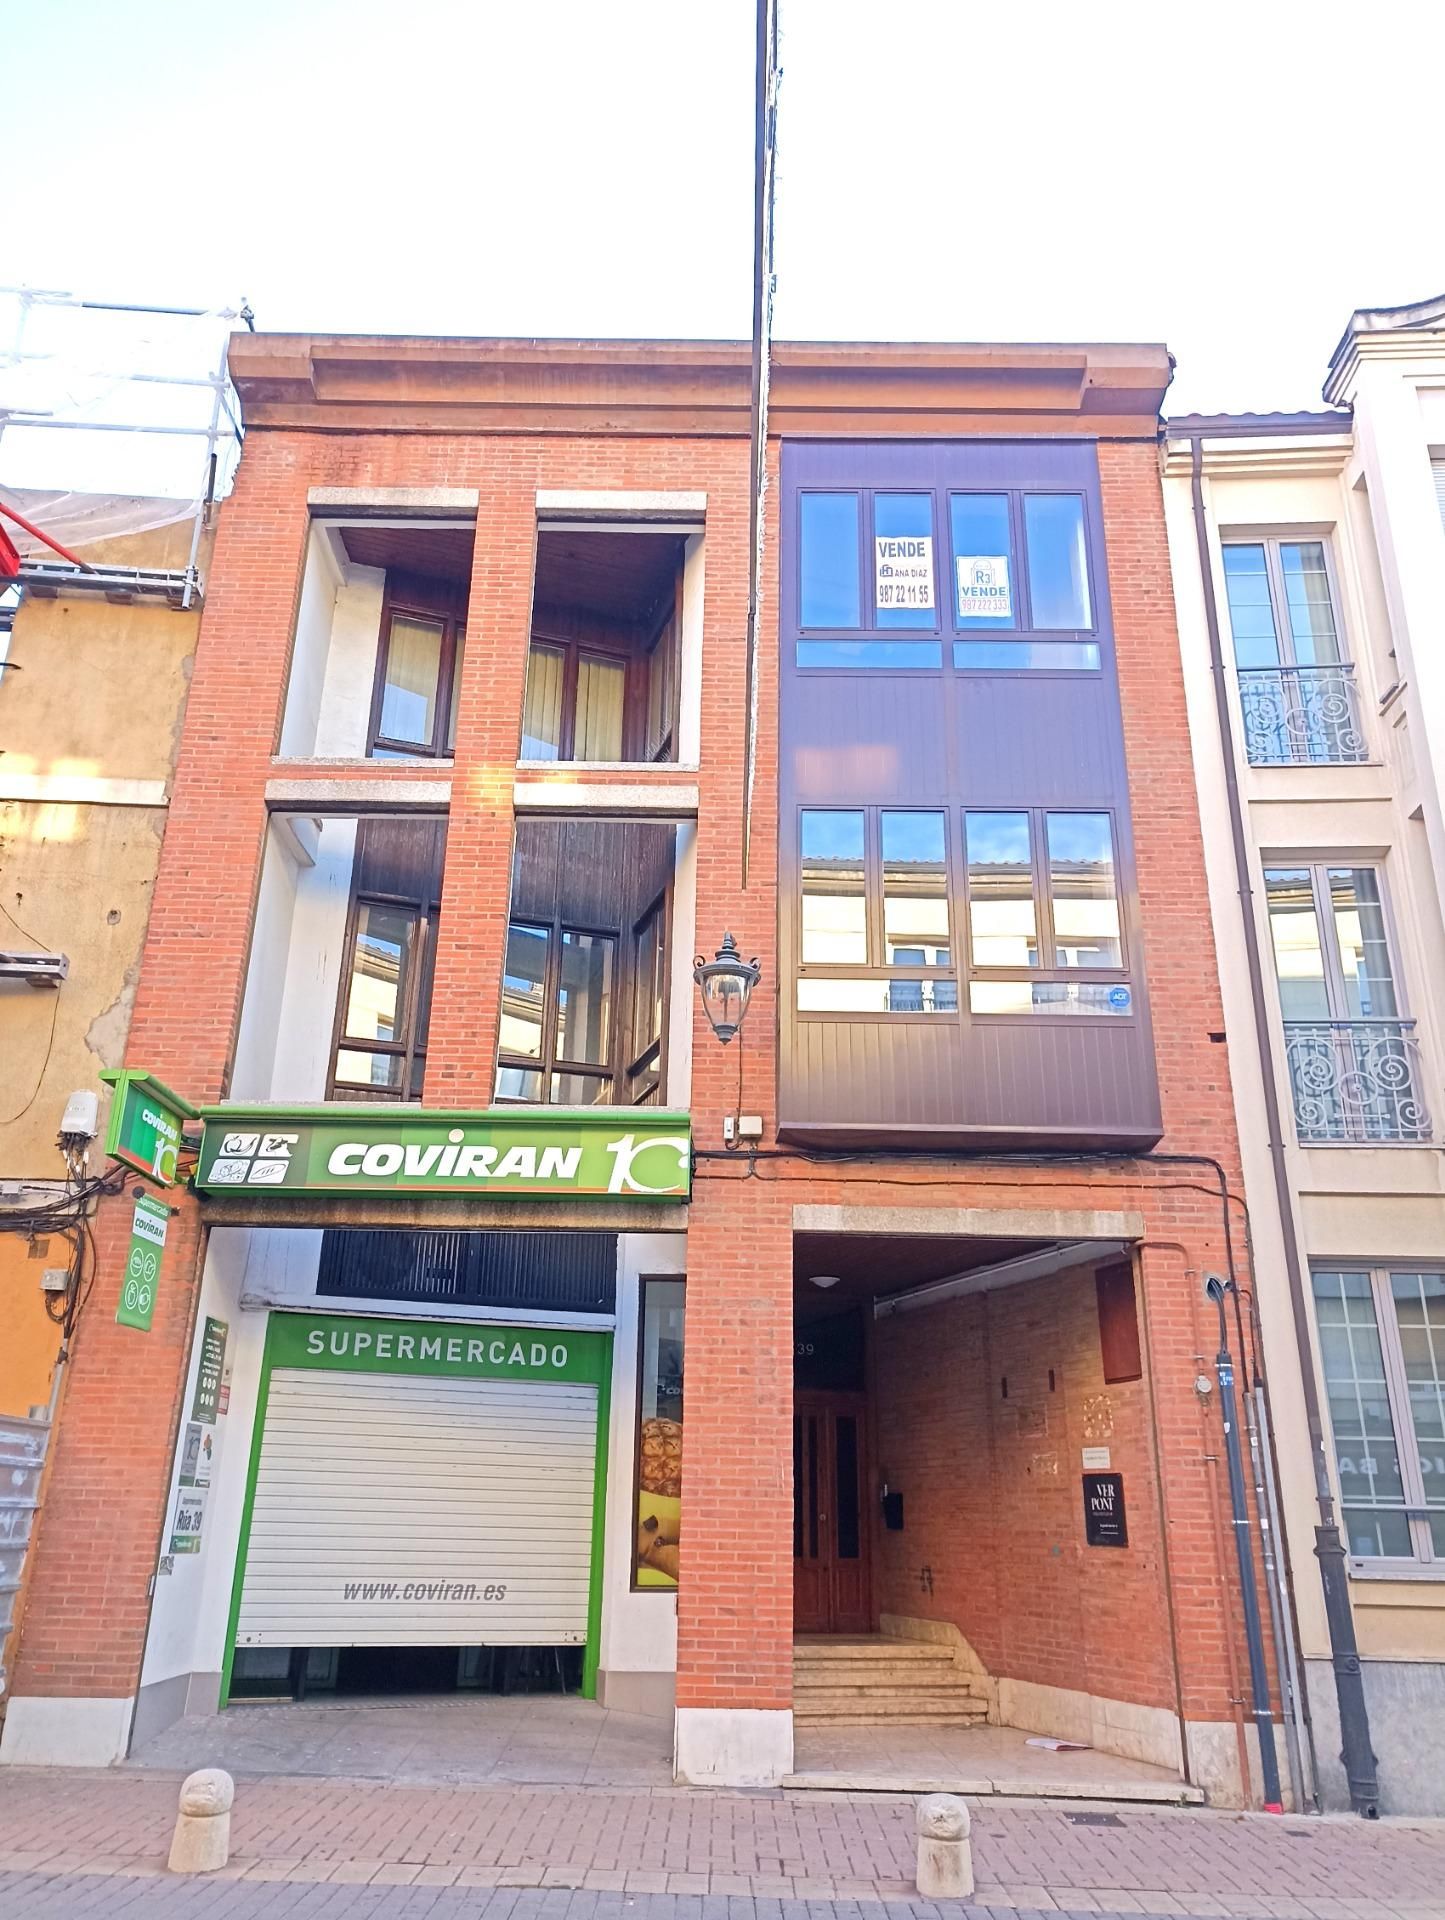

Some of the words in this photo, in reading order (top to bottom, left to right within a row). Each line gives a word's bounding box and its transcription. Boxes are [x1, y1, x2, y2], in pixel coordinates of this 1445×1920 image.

[879, 542, 925, 557] VENDE
[880, 585, 893, 602] 987
[896, 585, 905, 602] 22
[908, 585, 916, 602] 11
[919, 585, 928, 602] 55
[962, 586, 1006, 596] VENDE
[307, 1330, 568, 1368] SUPERMERCADO
[797, 1343, 814, 1355] 39
[1097, 1484, 1115, 1497] VER
[1091, 1498, 1114, 1511] PONT
[343, 1578, 507, 1600] www.coviran.es
